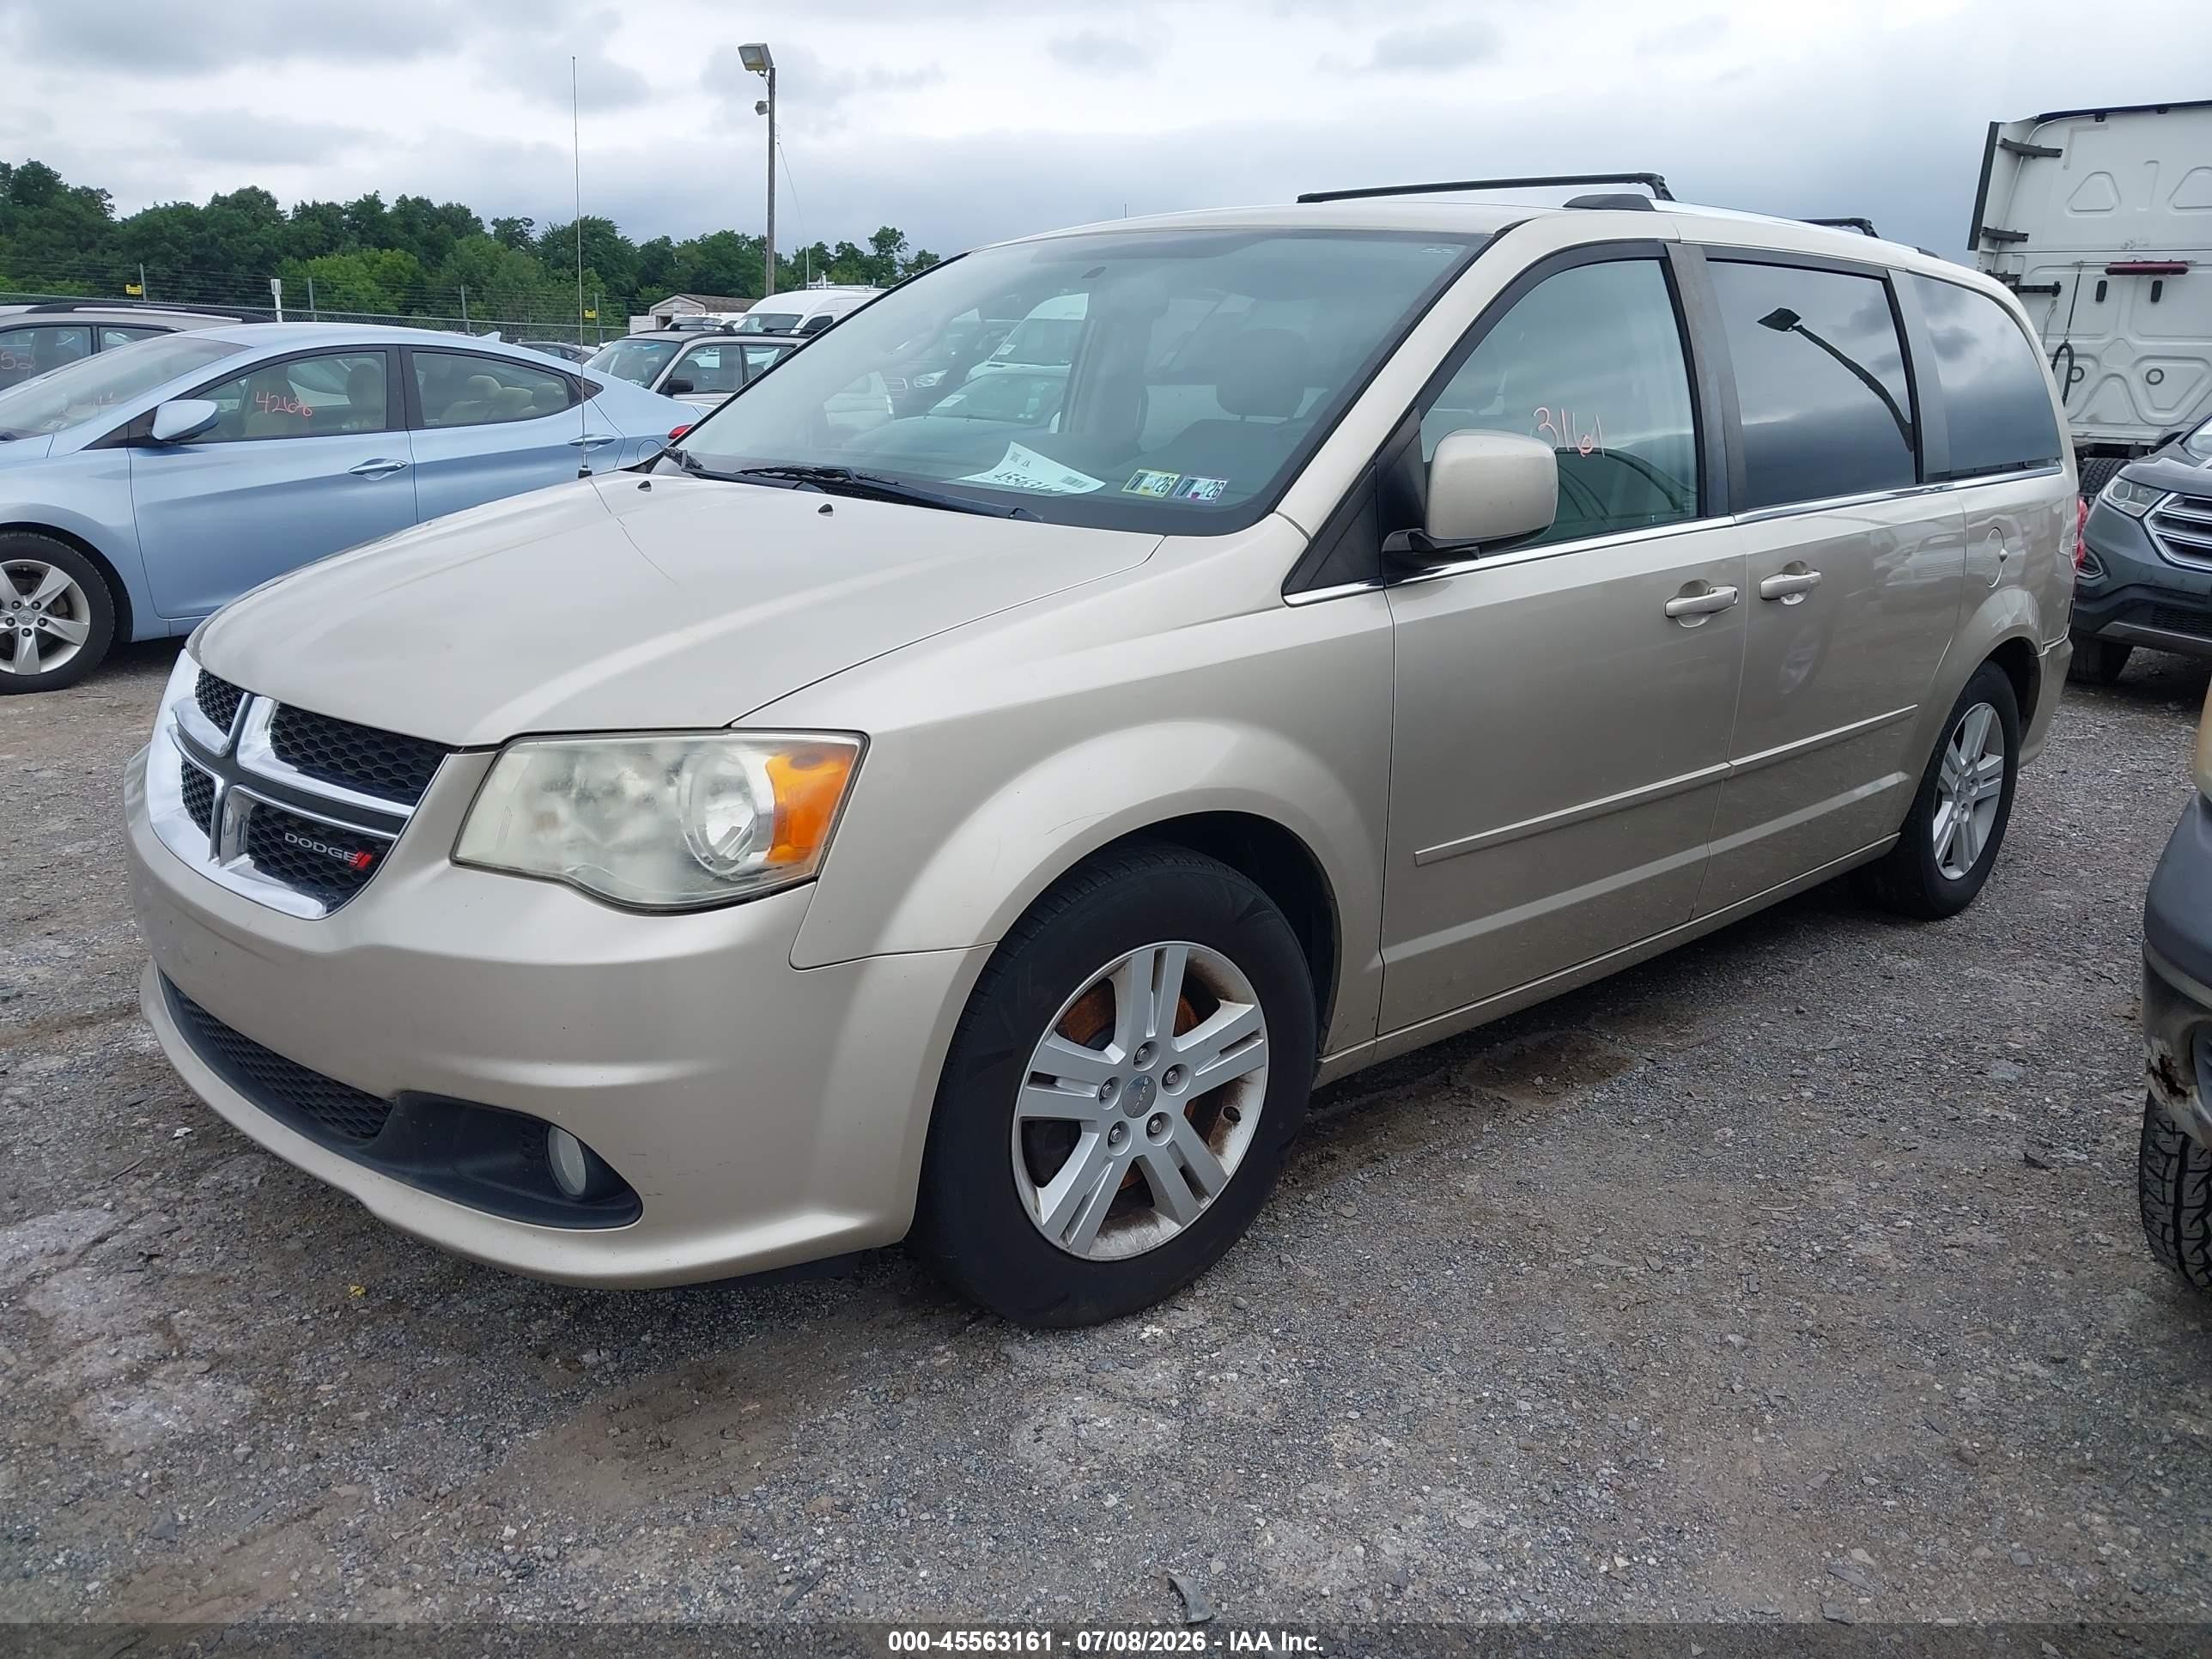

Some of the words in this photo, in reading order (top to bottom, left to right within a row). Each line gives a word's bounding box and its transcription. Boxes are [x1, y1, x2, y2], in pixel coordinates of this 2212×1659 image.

[255, 391, 313, 416] 4268
[1531, 407, 1605, 458] 3161
[284, 832, 358, 864] DODGE
